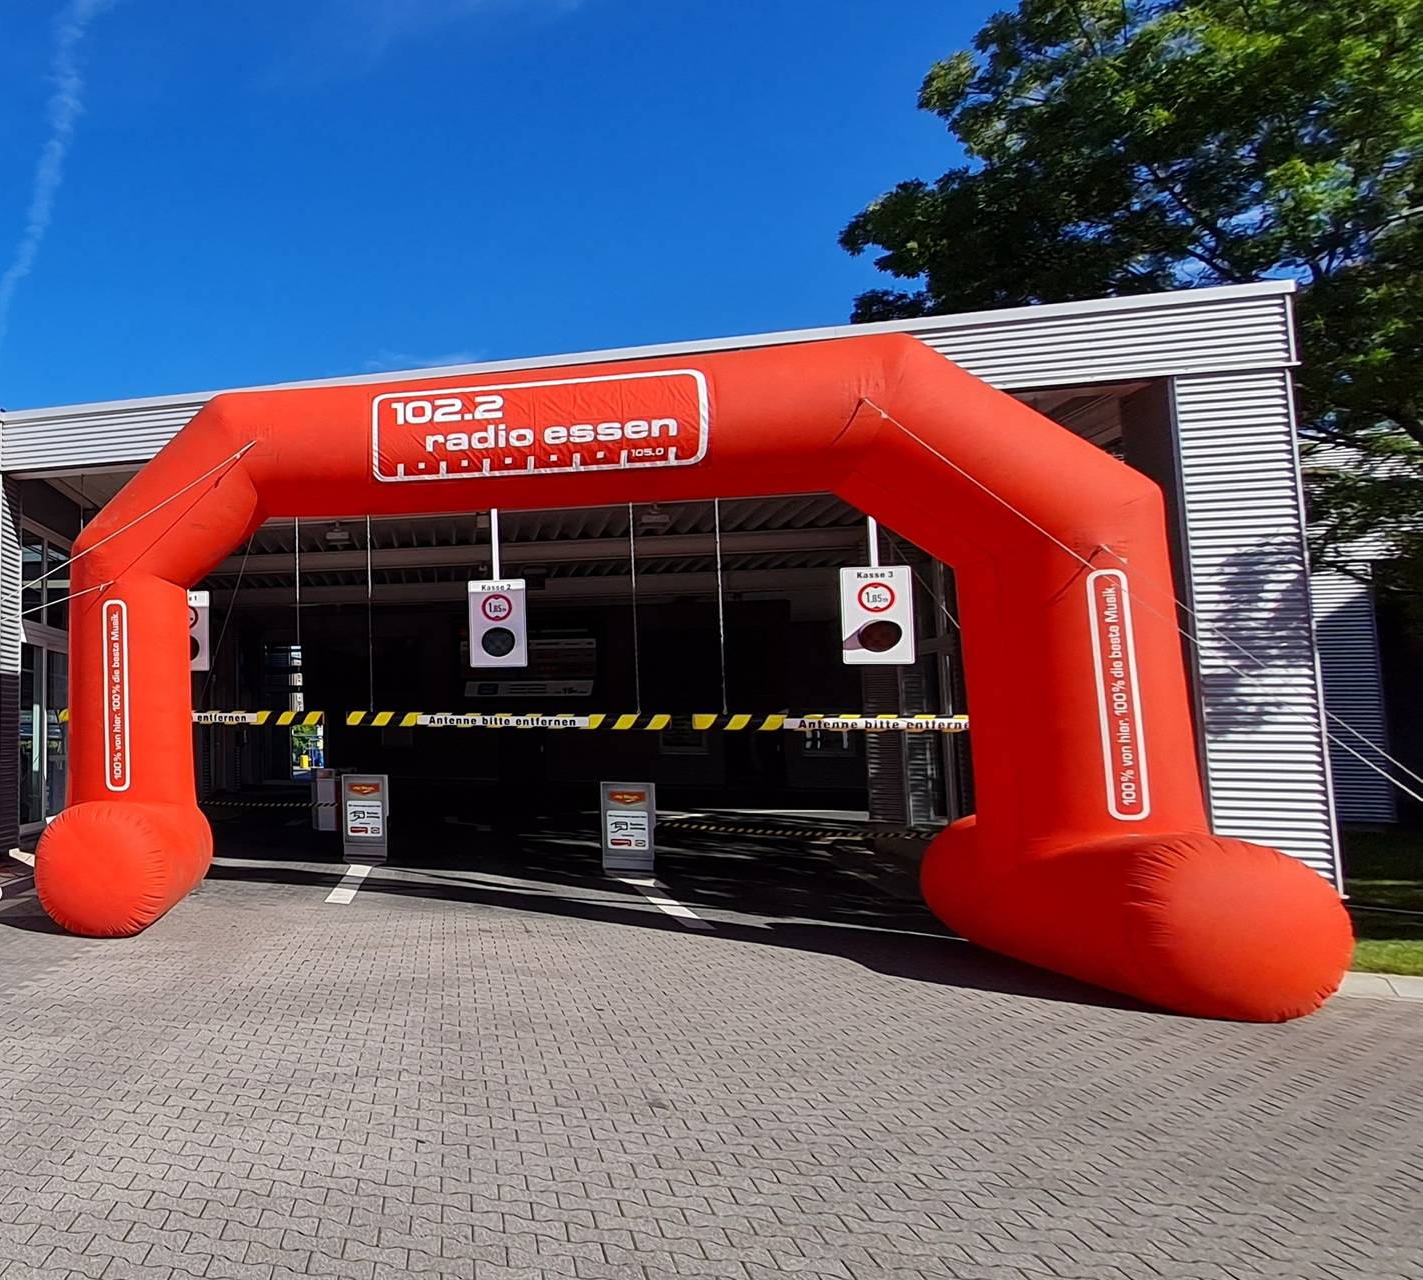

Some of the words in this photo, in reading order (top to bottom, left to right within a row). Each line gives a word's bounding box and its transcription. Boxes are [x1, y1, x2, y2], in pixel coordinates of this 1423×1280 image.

[391, 394, 504, 425] 102.2
[426, 423, 535, 452] radio
[543, 417, 678, 445] essen
[630, 447, 664, 457] 105.0
[507, 583, 512, 591] 2
[857, 571, 885, 579] Kasse
[1103, 584, 1118, 623] Musik.
[110, 611, 119, 641] Musik.
[111, 642, 120, 668] beste
[1108, 625, 1122, 659] beste
[111, 668, 121, 683] die
[1110, 661, 1125, 678] die
[112, 684, 121, 712] 100%
[1112, 679, 1128, 717] 100%
[113, 713, 122, 732] hier.
[197, 713, 247, 722] entfernen
[429, 715, 478, 725] Antenne
[482, 716, 510, 726] bitte
[515, 716, 576, 727] entfernen
[798, 719, 858, 729] Antenne
[864, 719, 899, 729] bitte
[1116, 717, 1131, 744] hier.
[113, 752, 122, 780] 100%
[1122, 745, 1133, 767] von
[1121, 767, 1137, 805] 100%
